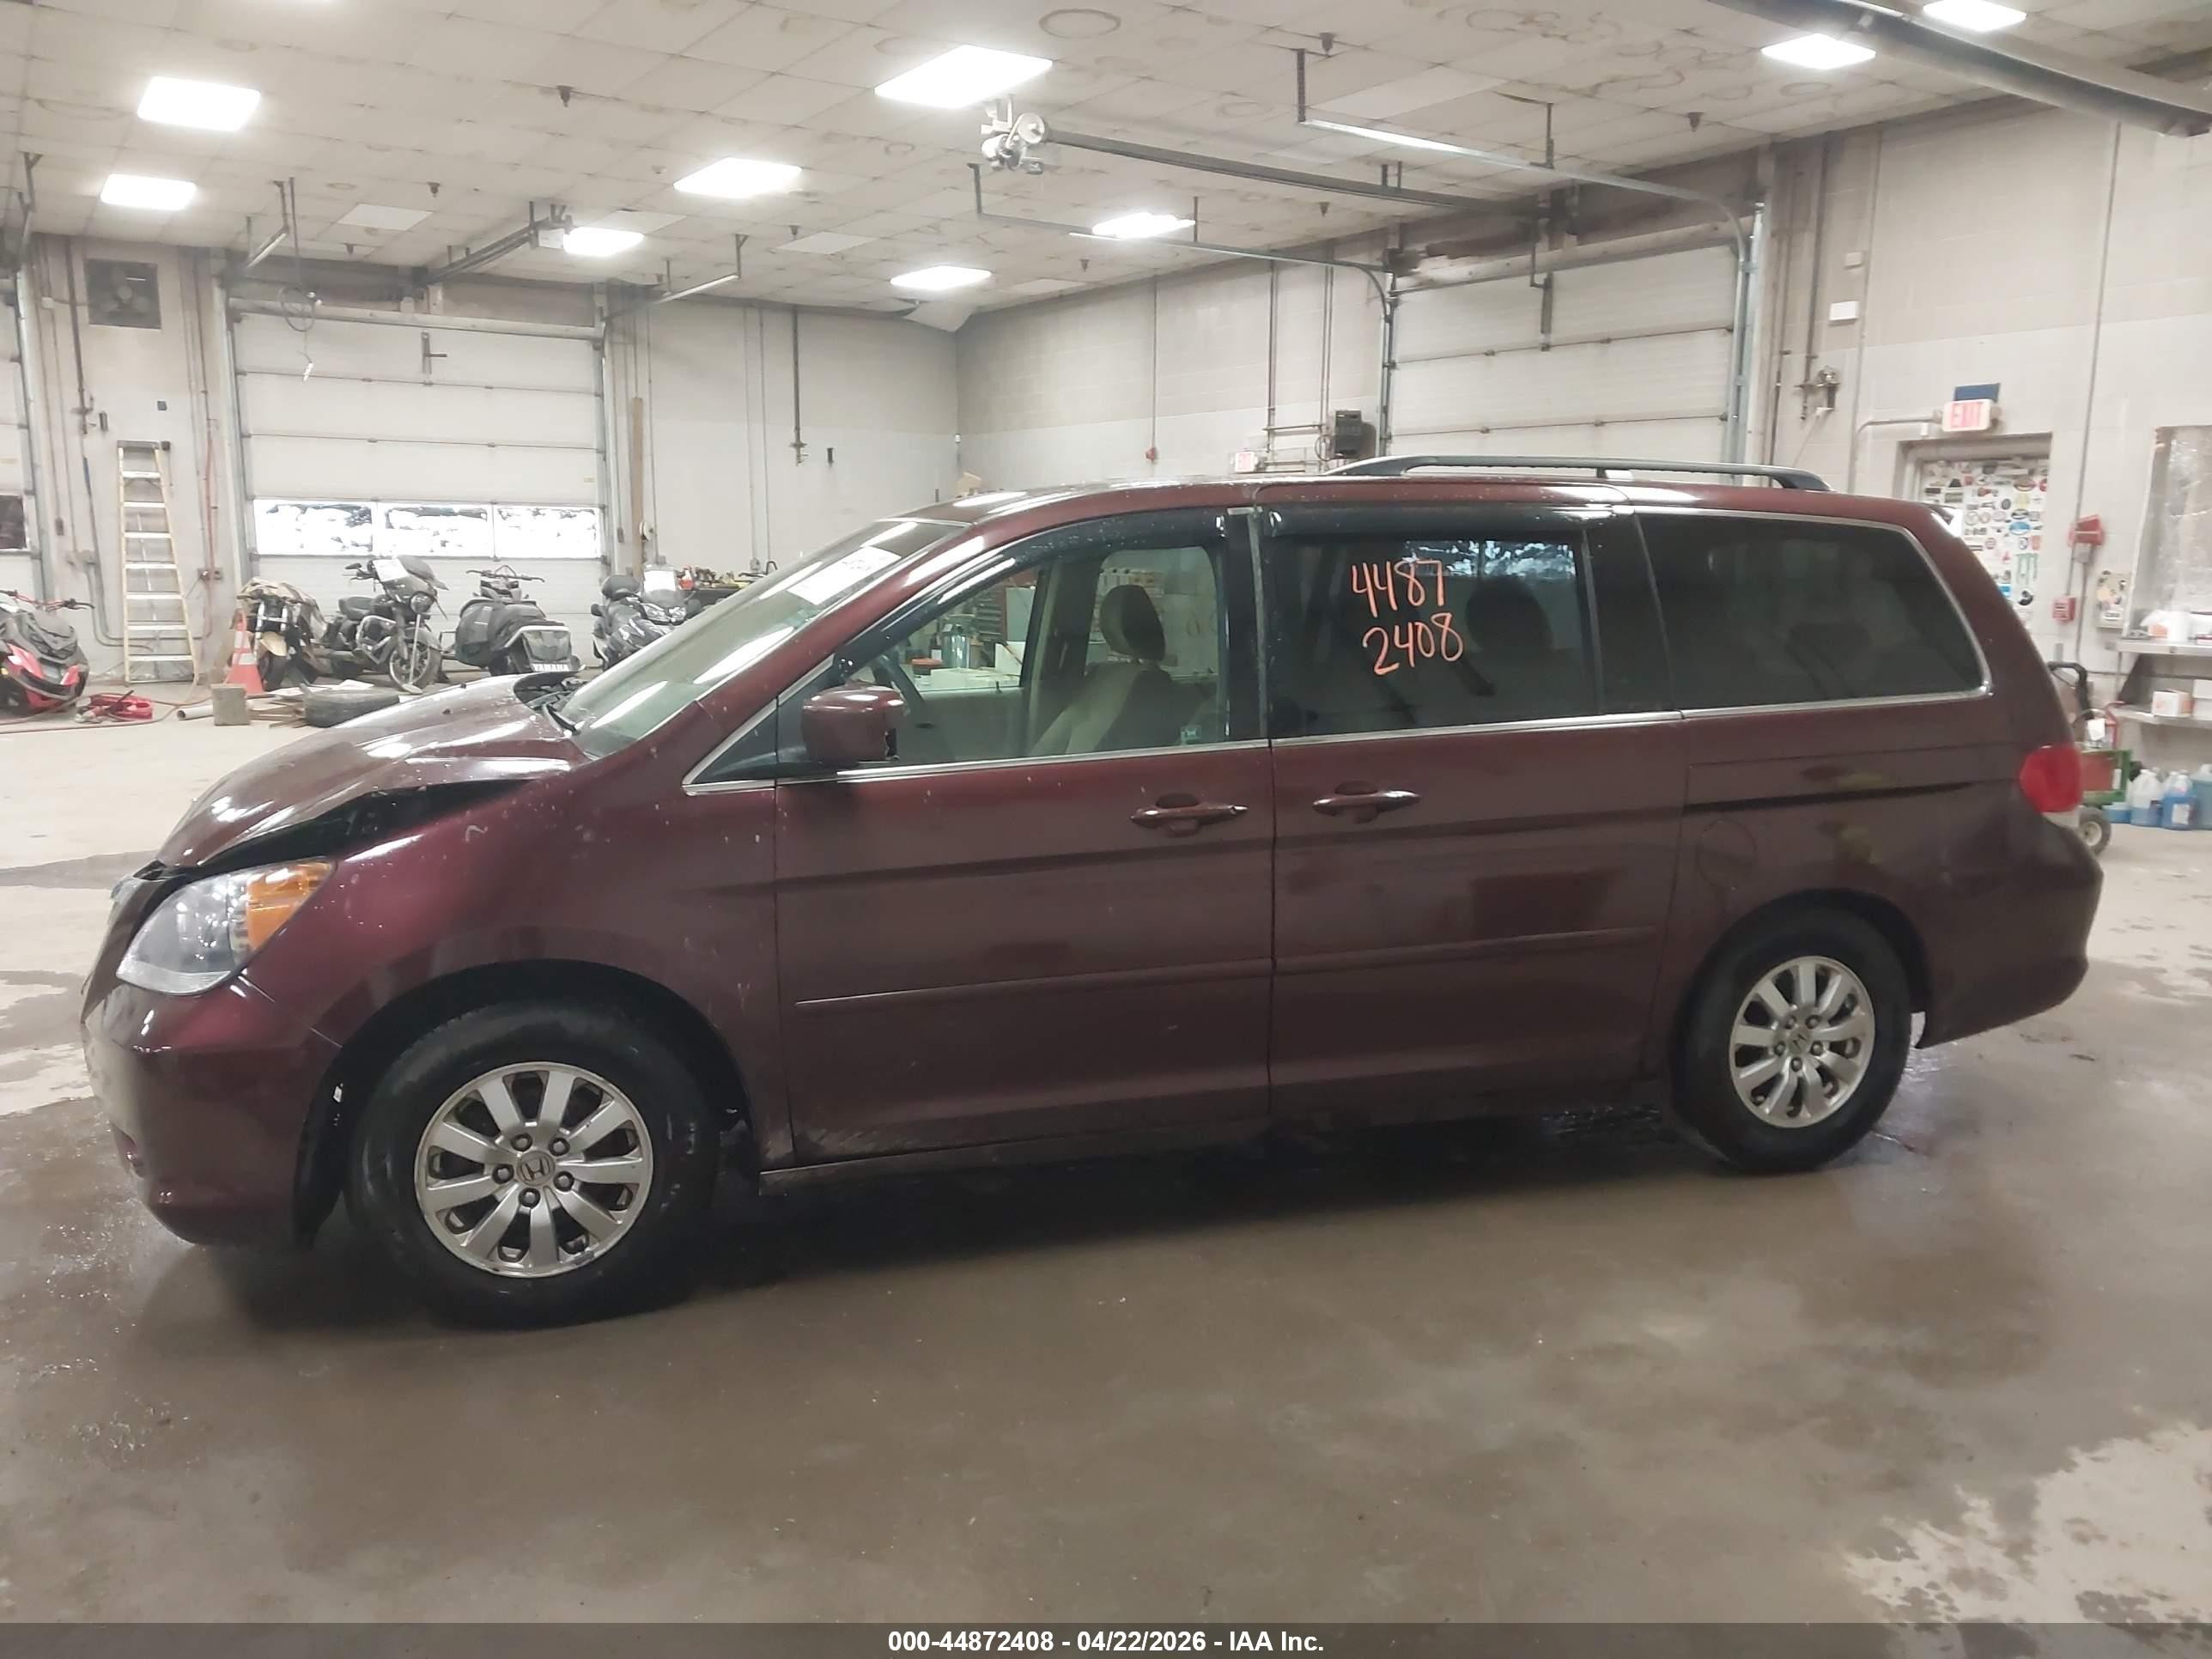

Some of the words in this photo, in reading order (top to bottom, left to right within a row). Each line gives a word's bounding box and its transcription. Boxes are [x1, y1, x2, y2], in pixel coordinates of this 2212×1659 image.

[1351, 558, 1445, 618] 4487
[531, 663, 570, 672] YAMAHA
[1362, 611, 1463, 675] 2408
